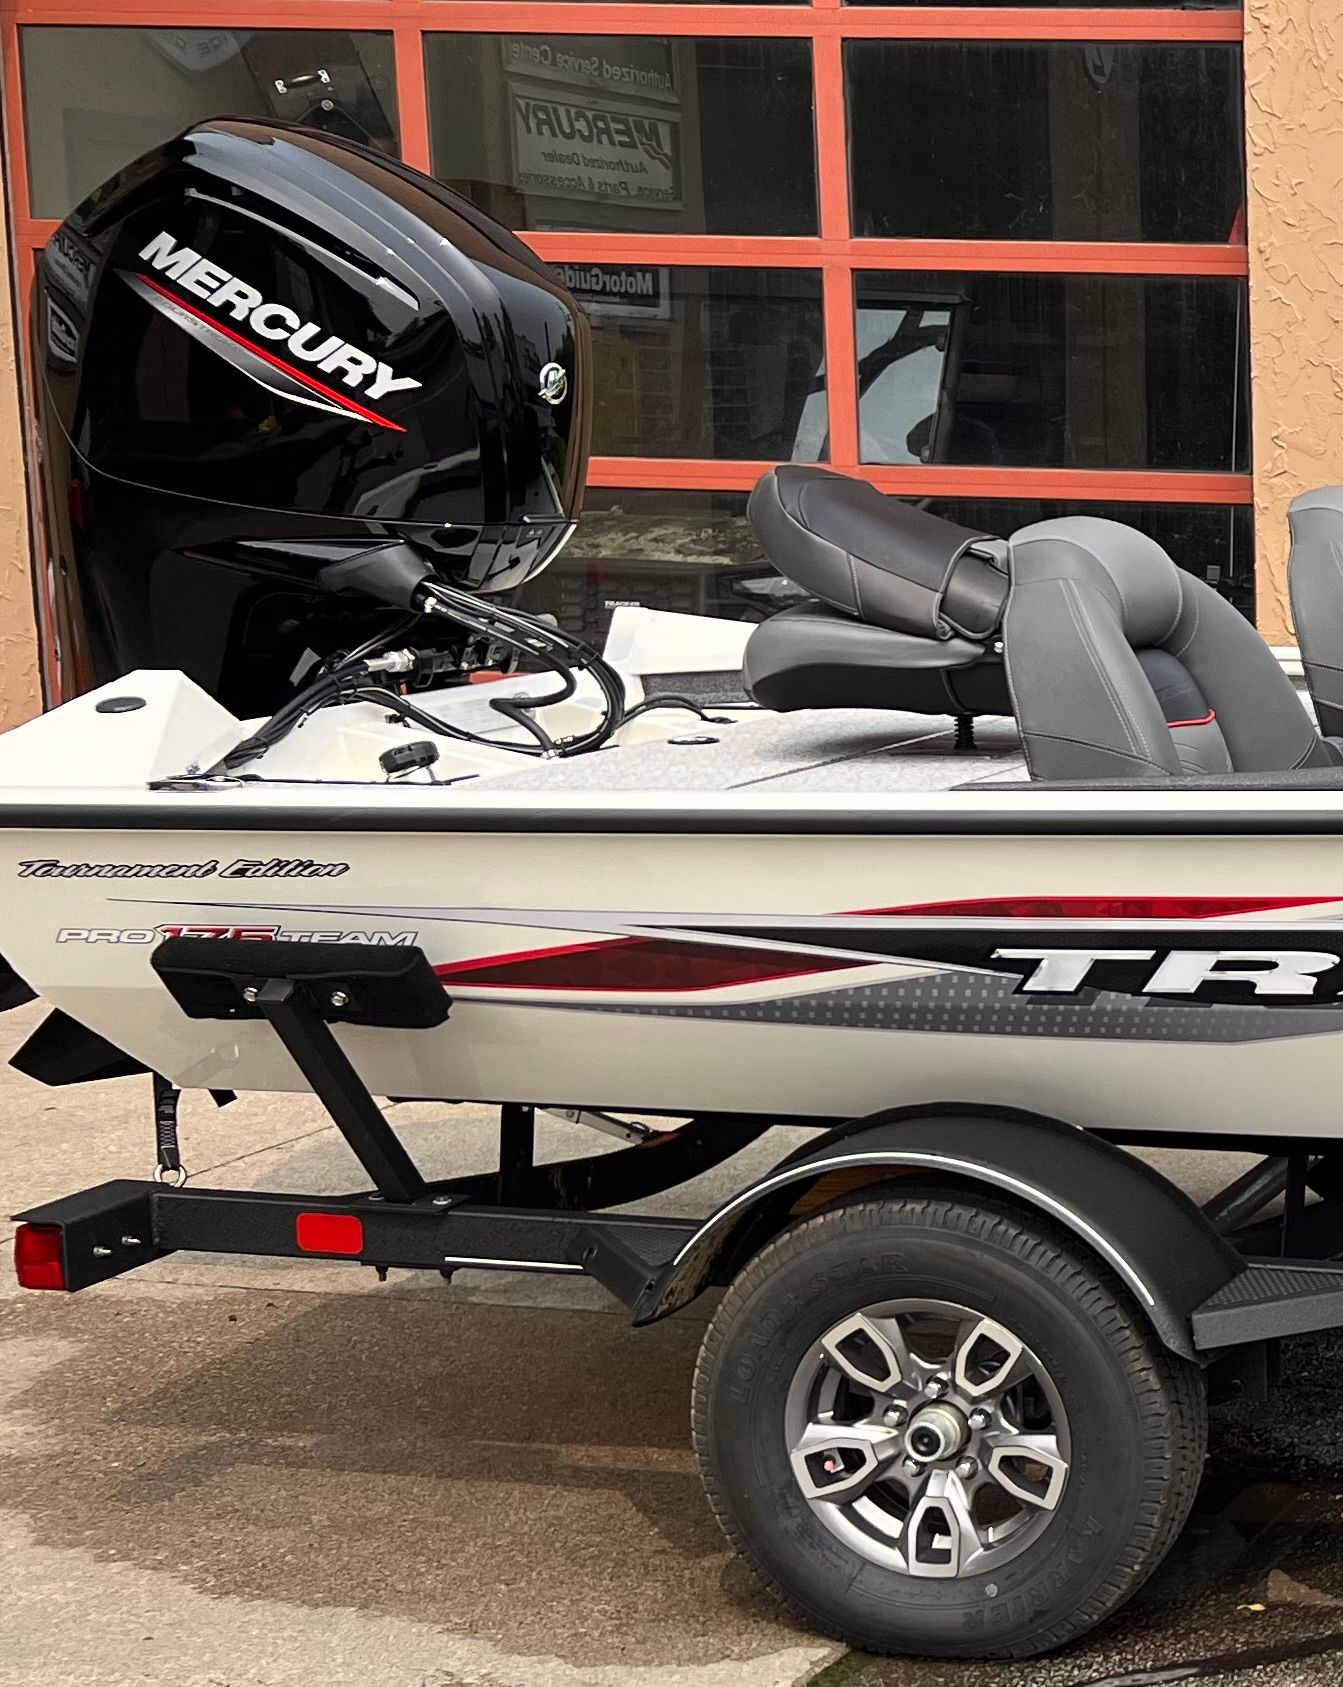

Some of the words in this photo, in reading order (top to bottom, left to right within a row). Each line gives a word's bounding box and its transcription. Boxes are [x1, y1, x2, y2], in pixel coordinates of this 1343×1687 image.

[138, 231, 422, 400] MERCURY
[18, 859, 219, 878] Tournament
[219, 859, 350, 878] Edition
[56, 928, 155, 944] PRO
[278, 931, 419, 947] TEAM
